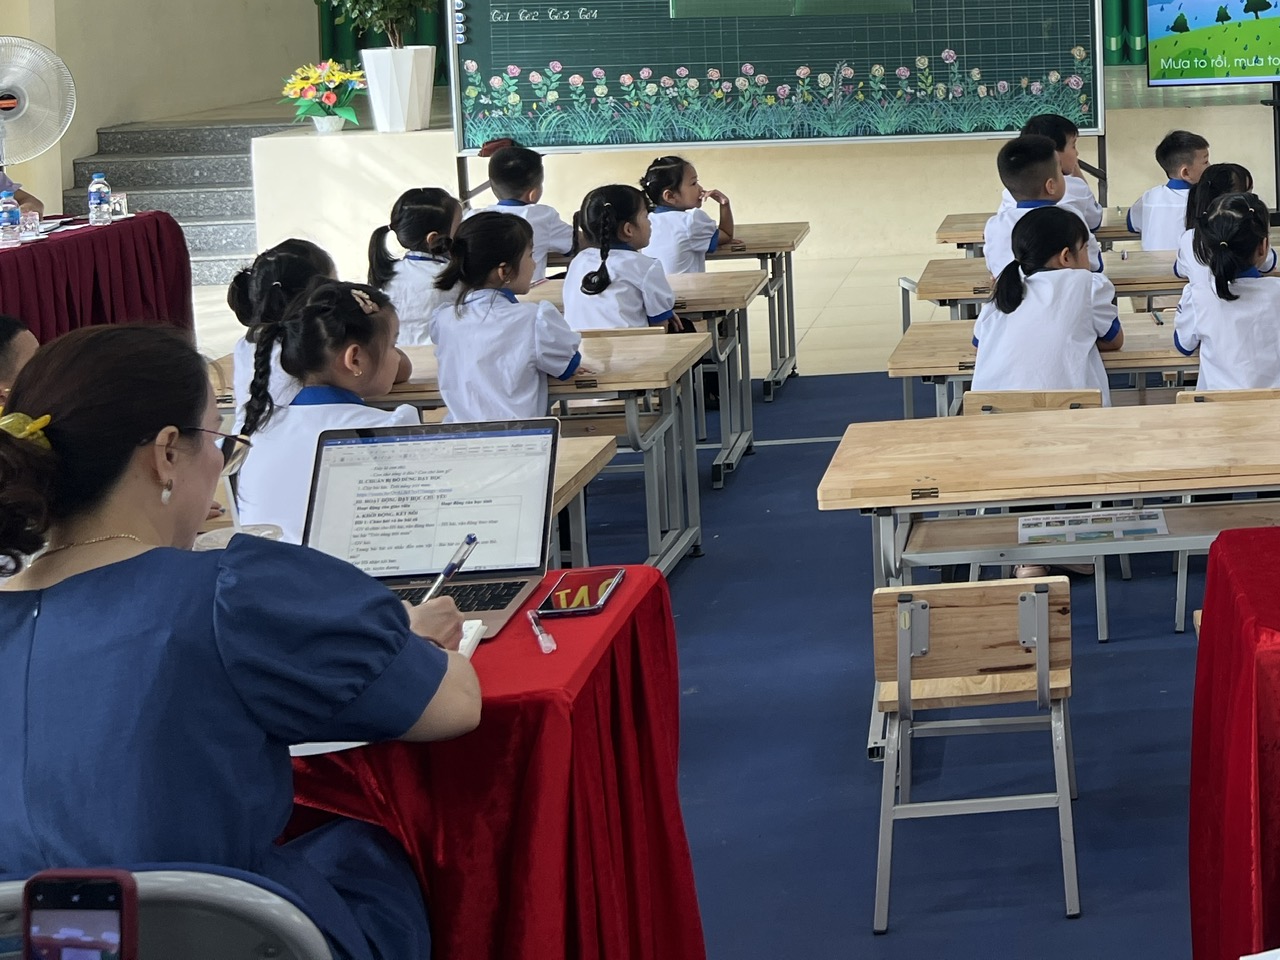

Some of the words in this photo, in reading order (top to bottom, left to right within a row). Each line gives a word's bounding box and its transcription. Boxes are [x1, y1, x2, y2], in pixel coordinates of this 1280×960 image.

[1160, 57, 1191, 70] Mưa
[1194, 58, 1207, 68] to
[1211, 54, 1231, 69] rồi,
[1234, 56, 1264, 68] mưa
[1268, 56, 1280, 67] to
